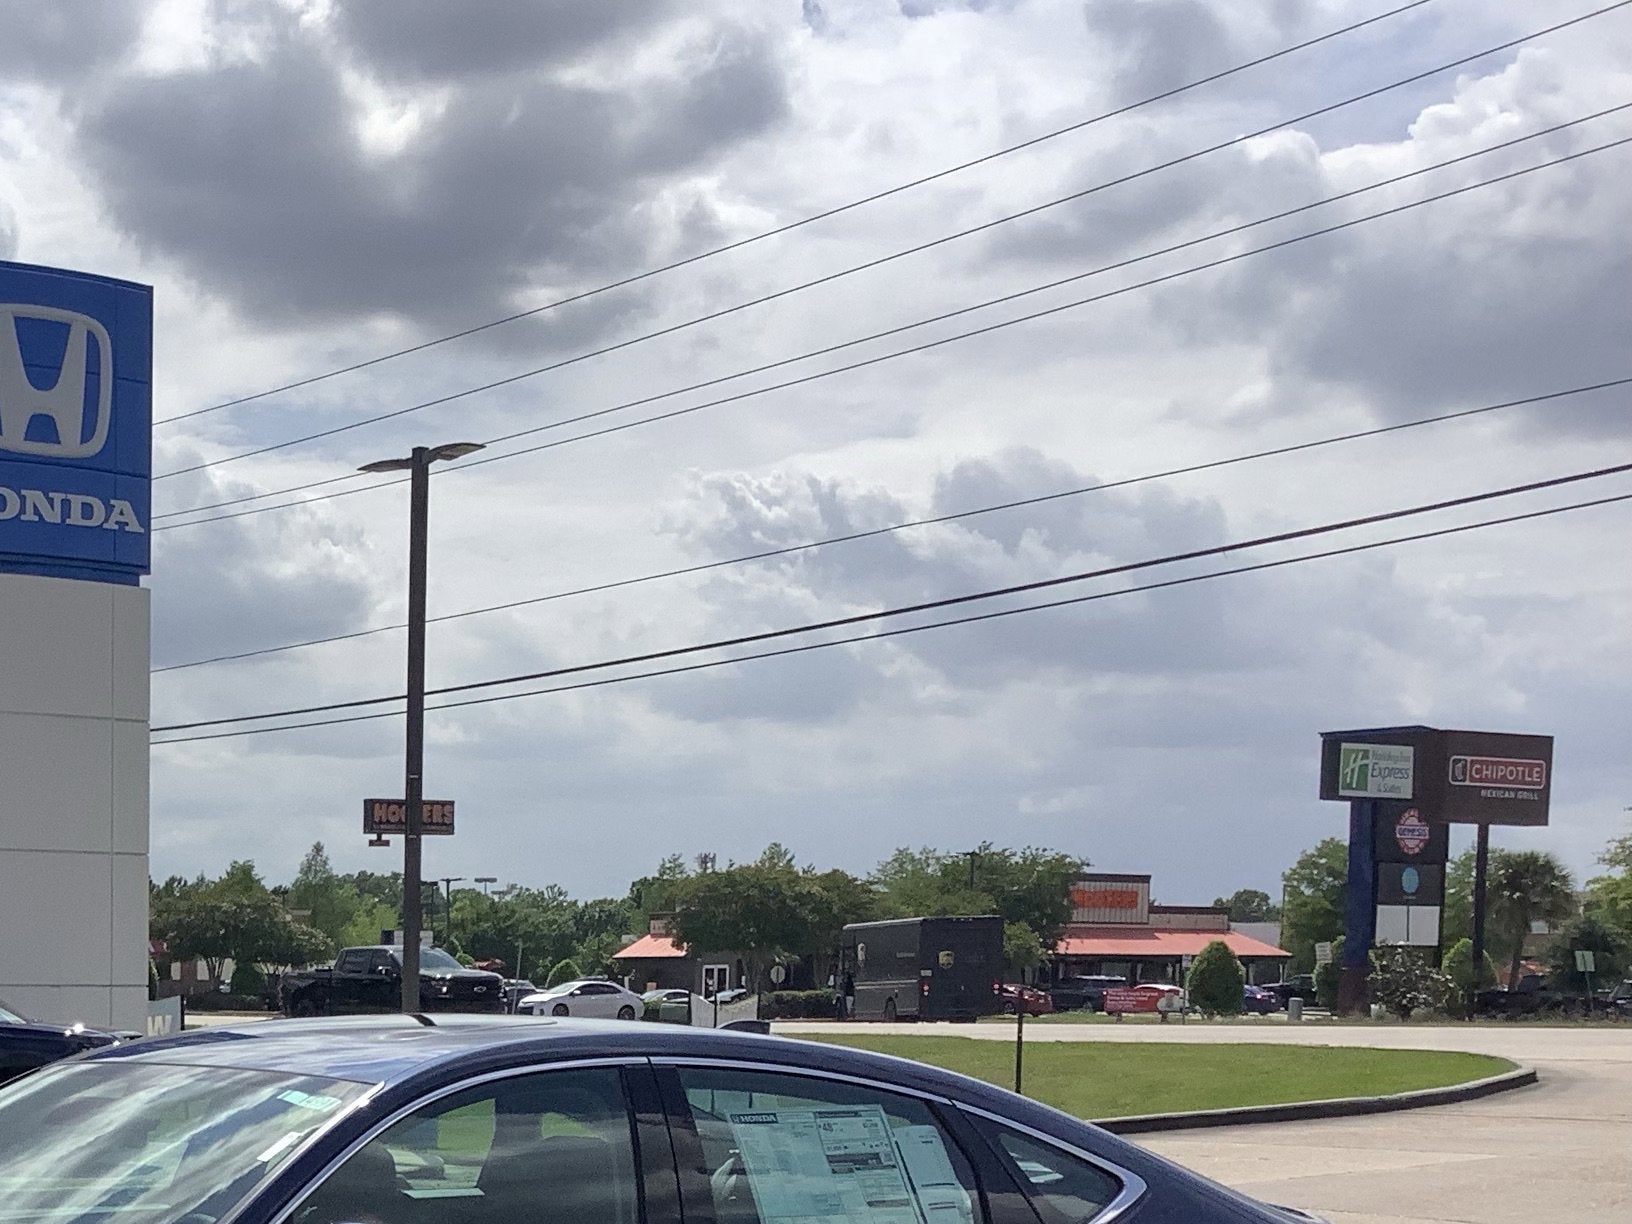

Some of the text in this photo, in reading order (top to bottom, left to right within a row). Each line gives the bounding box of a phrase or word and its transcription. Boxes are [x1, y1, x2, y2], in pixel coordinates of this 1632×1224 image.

[1371, 762, 1410, 780] Express
[1471, 764, 1541, 782] CHIPOTLE
[1480, 789, 1539, 801] MEXICAN GRILL
[374, 803, 453, 824] HOERS
[740, 1115, 777, 1124] HONDA
